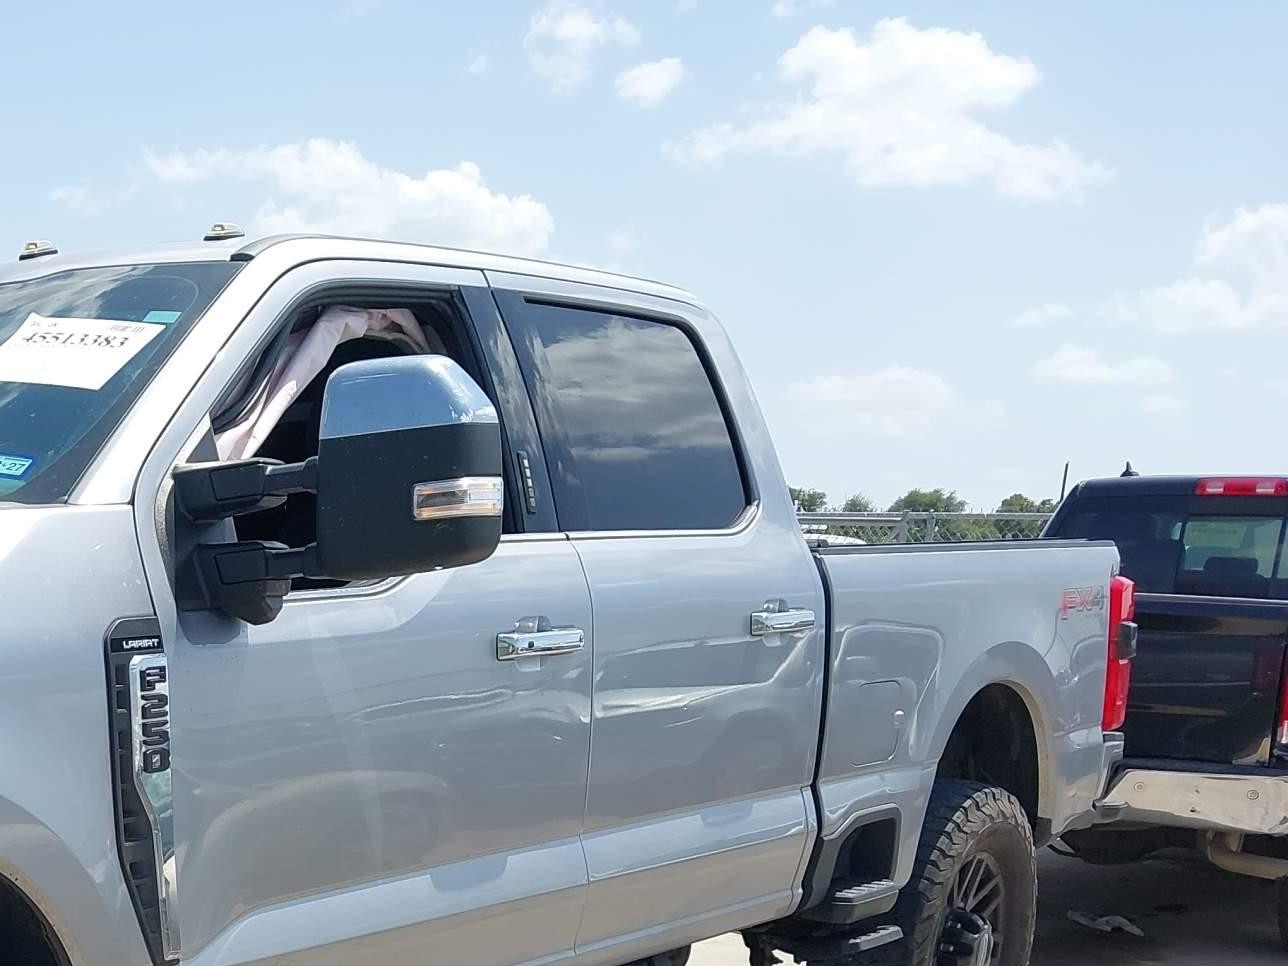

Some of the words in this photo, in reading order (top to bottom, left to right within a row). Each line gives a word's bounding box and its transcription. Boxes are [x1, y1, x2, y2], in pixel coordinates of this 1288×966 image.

[22, 332, 129, 348] 45513383
[1059, 586, 1105, 619] FX4
[122, 638, 160, 650] LARIAT
[139, 665, 171, 774] F250
